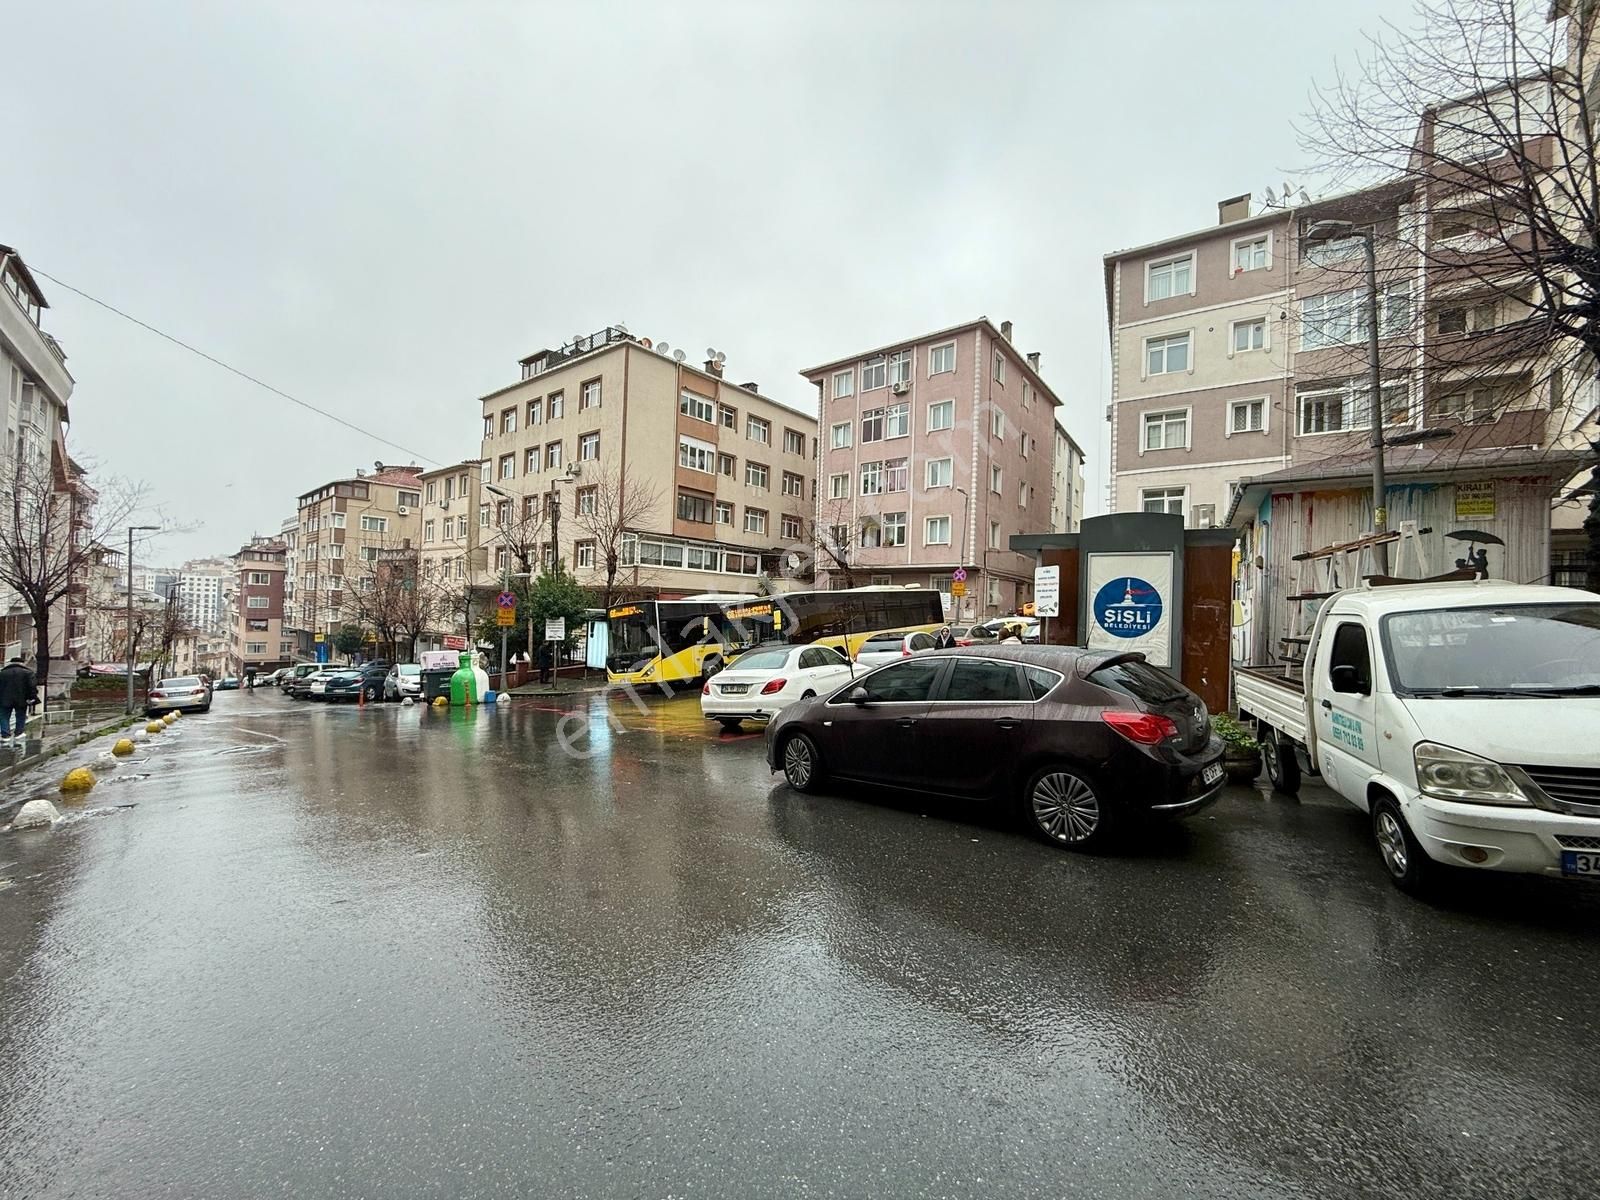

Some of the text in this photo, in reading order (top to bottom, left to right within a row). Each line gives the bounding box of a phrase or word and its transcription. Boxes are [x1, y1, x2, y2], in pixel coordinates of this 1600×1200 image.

[1457, 482, 1492, 491] KİRALIK
[1104, 609, 1151, 623] ŞİŞLİ
[1104, 622, 1151, 630] BELEDİYESİ
